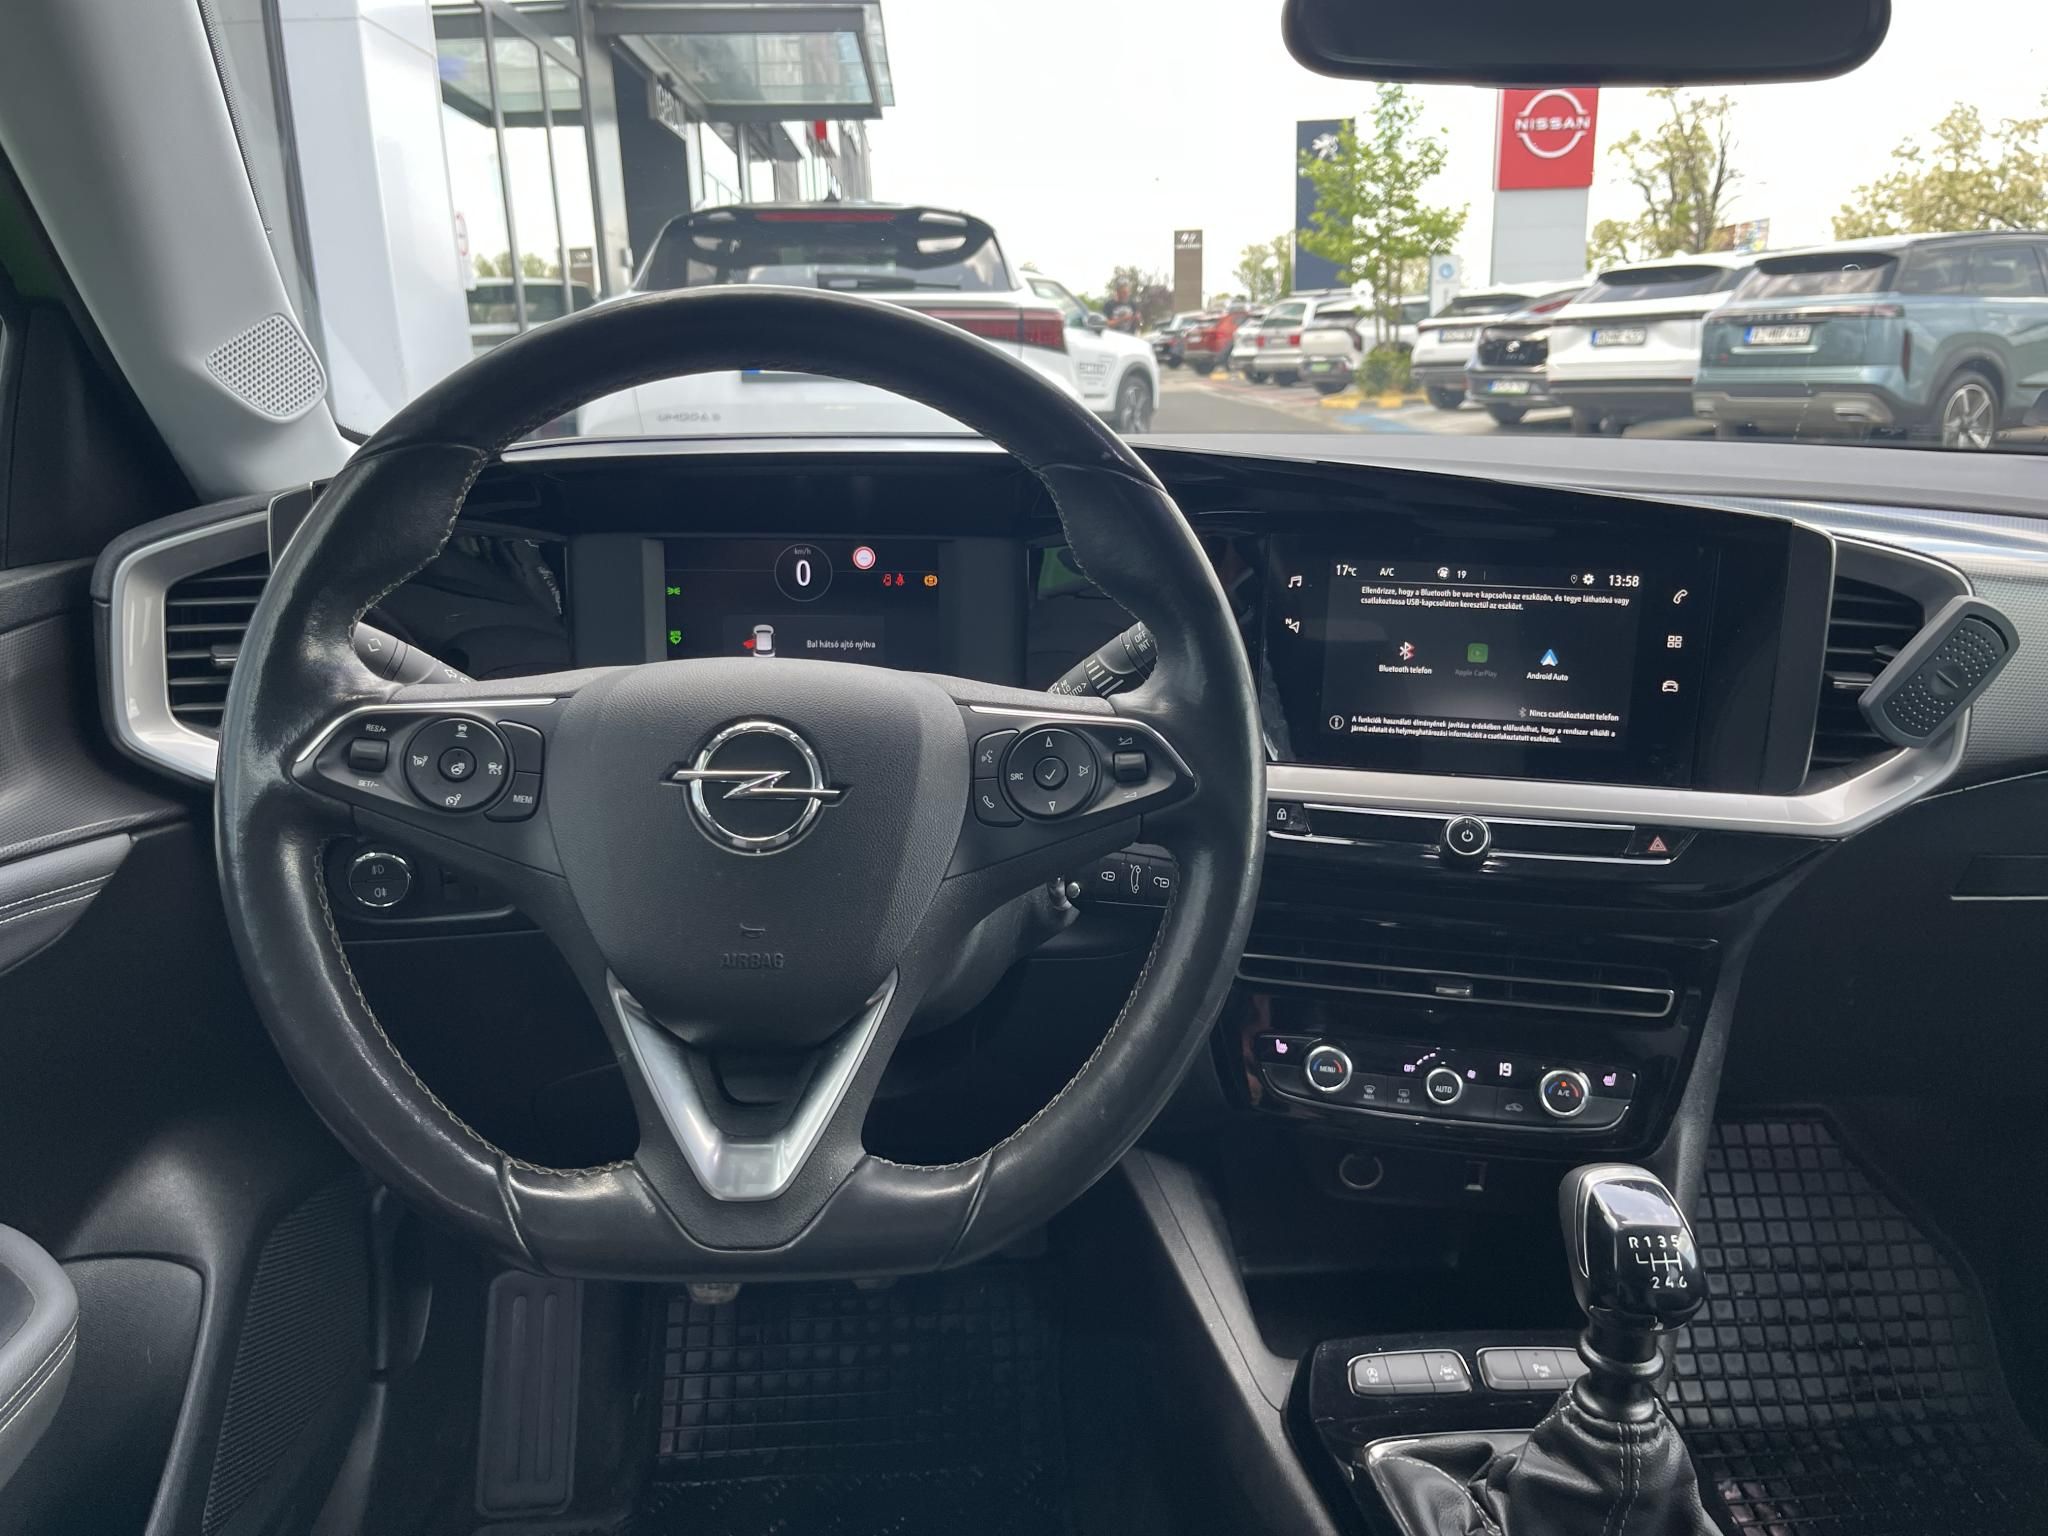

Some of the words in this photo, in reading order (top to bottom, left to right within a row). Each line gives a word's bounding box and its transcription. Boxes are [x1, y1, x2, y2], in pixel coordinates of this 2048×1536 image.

[1514, 116, 1591, 131] NISSAN
[794, 547, 811, 555] km/h
[796, 559, 811, 587] 0
[1379, 567, 1395, 577] A/C
[1457, 570, 1467, 579] 19
[1608, 574, 1640, 588] 13:58
[1360, 597, 1406, 606] csatlakoztassa
[1398, 587, 1414, 597] hogy
[1420, 588, 1452, 598] Bluetooth
[1452, 589, 1461, 598] be
[1461, 591, 1480, 599] van-e
[1481, 590, 1512, 601] kapcsolva
[1554, 594, 1563, 602] és
[1563, 594, 1582, 604] tegye
[1613, 597, 1630, 607] vagy
[806, 639, 818, 649] Bal
[819, 639, 839, 649] hátsó
[840, 639, 854, 651] ajtó
[855, 640, 876, 651] nyitva
[1378, 664, 1409, 674] Bluetooth
[1410, 665, 1433, 675] telefon
[1526, 671, 1552, 681] Android
[1552, 672, 1569, 681] Auto
[1529, 709, 1547, 718] Nincs
[1548, 710, 1595, 721] csatlakoztatott
[1595, 712, 1619, 722] telefon
[1351, 715, 1357, 723] A
[1541, 726, 1556, 736] hogy
[1563, 727, 1589, 736] rendszer
[1009, 772, 1024, 781] SRC
[512, 794, 533, 804] MEM
[719, 952, 785, 969] AIRBAG
[1319, 1065, 1336, 1073] MENU
[1403, 1064, 1416, 1073] OFF
[1499, 1062, 1513, 1077] 19
[1435, 1085, 1453, 1094] AUTO
[1557, 1089, 1570, 1097] A/C
[1628, 1236, 1639, 1249] R
[1643, 1235, 1651, 1248] 1
[1657, 1234, 1667, 1248] 3
[1670, 1234, 1680, 1248] 5
[1651, 1276, 1660, 1289] 2
[1665, 1275, 1674, 1289] 4
[1678, 1275, 1688, 1289] 6
